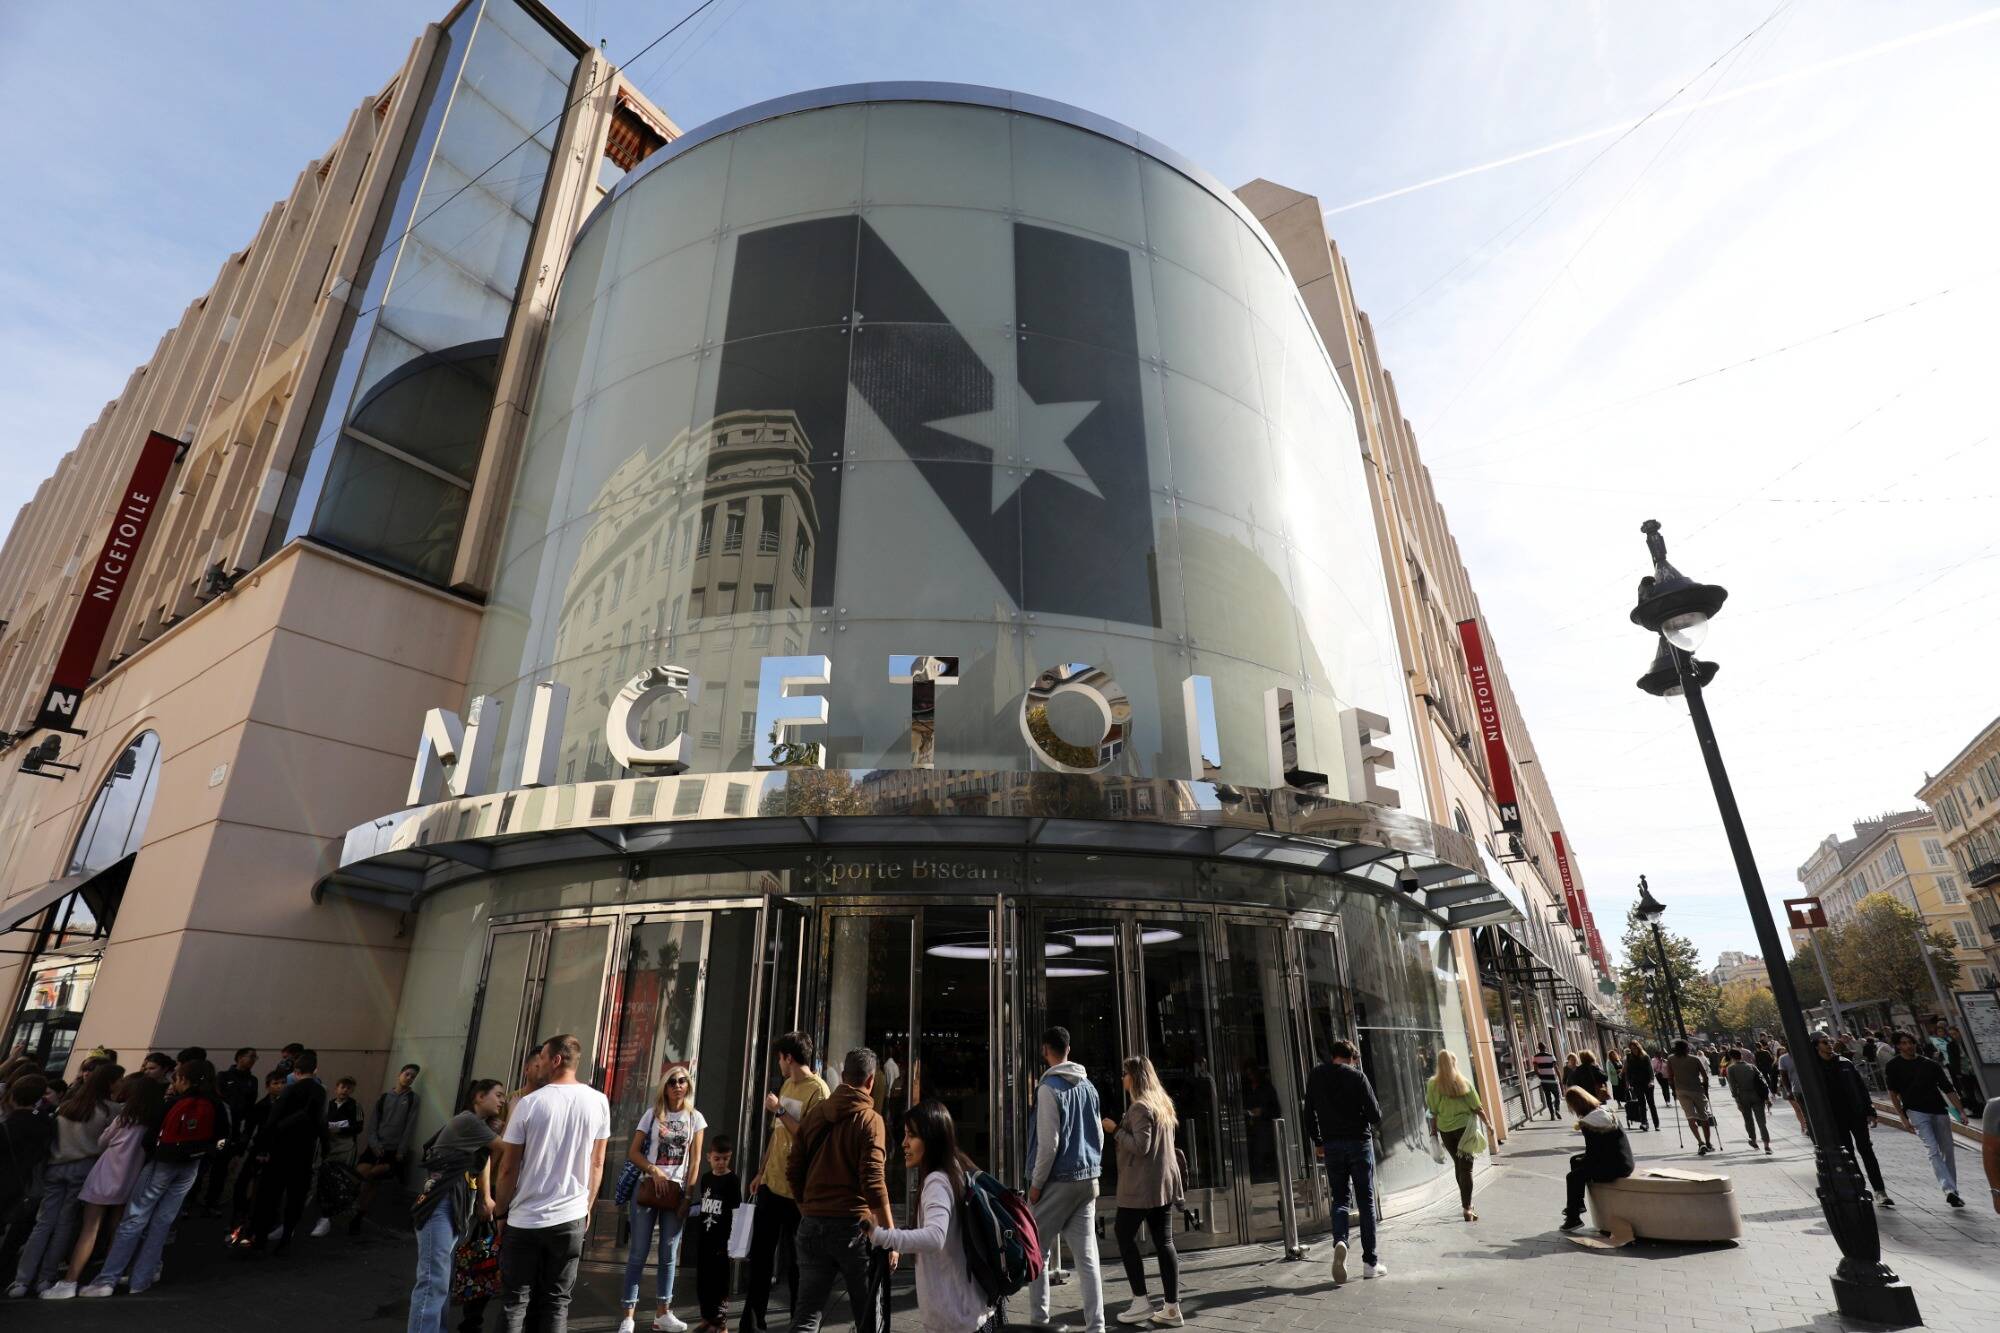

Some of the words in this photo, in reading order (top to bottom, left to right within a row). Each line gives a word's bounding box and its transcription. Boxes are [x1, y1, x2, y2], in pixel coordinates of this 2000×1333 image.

[93, 491, 150, 601] NICETOILE
[47, 690, 77, 715] N
[1473, 665, 1499, 741] NICETOILE
[407, 655, 1401, 809] NICETOILE
[1501, 806, 1518, 821] N
[831, 860, 902, 885] porte
[1559, 856, 1574, 897] NICETOILE
[1790, 902, 1818, 925] T
